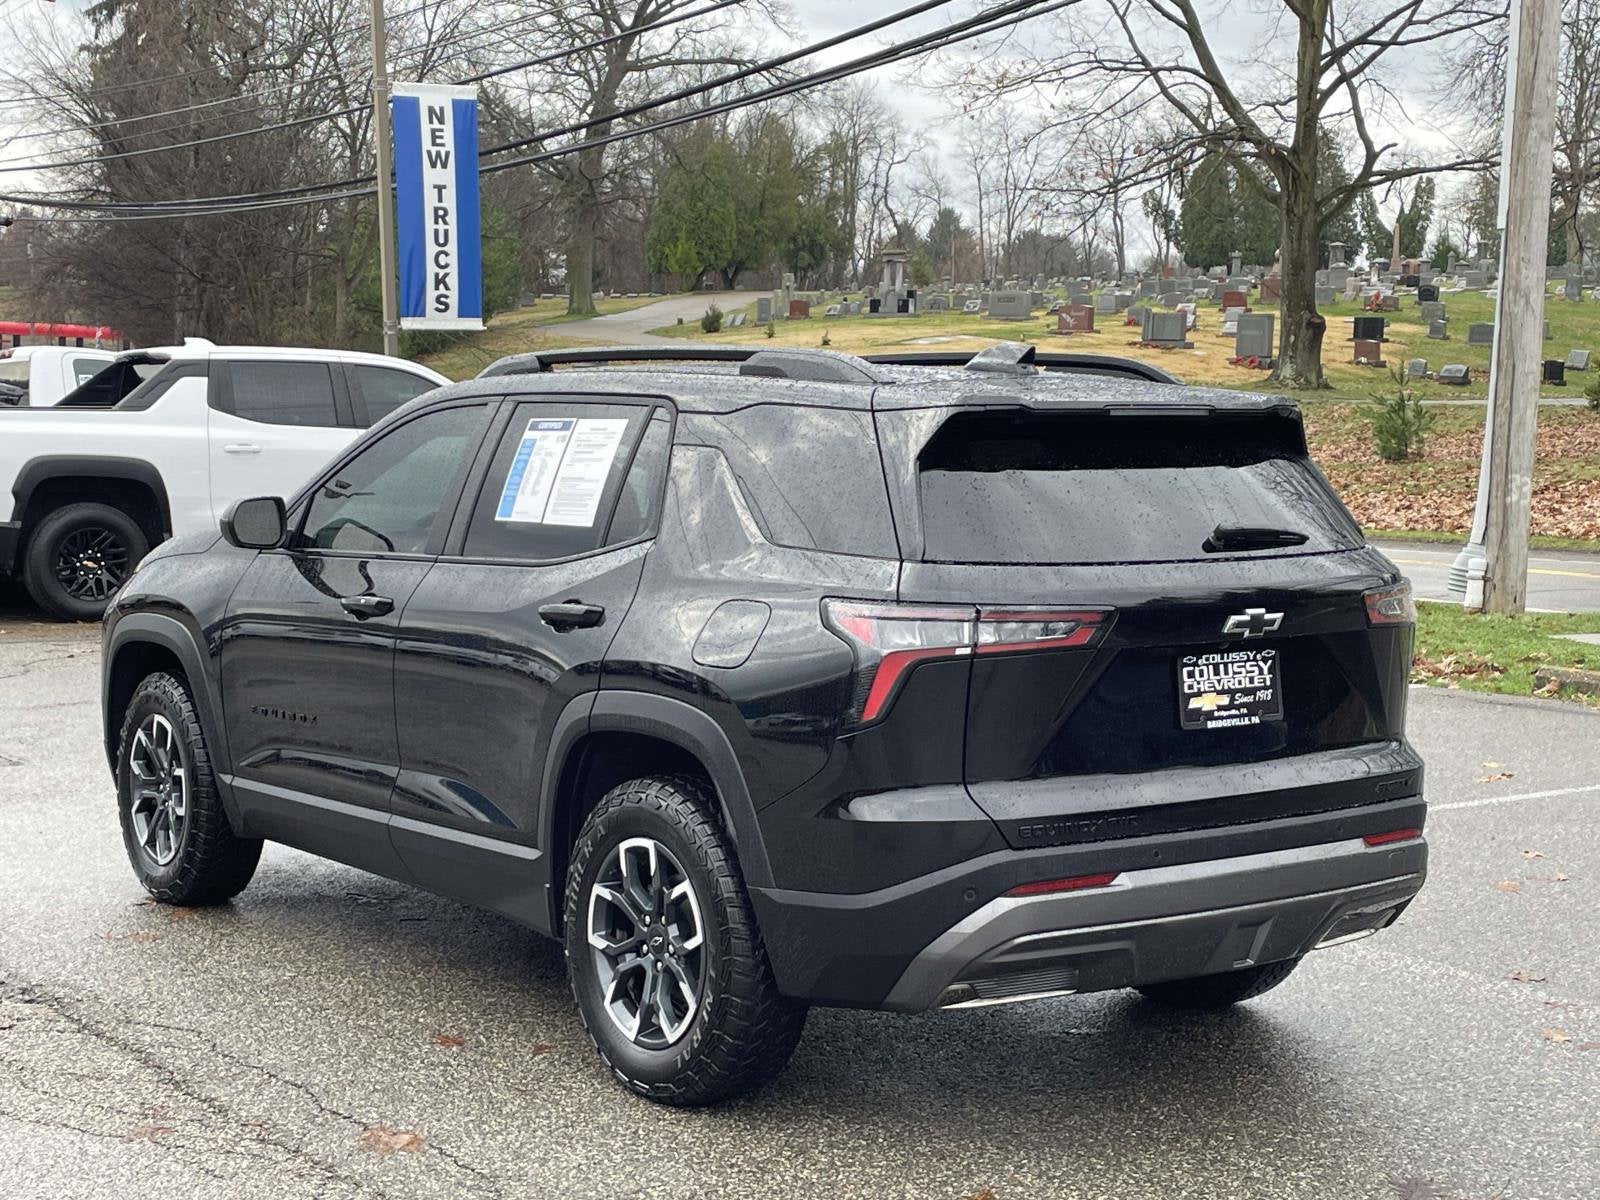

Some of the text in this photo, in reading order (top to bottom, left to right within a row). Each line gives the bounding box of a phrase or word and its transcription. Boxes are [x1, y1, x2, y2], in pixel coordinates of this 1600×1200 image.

[426, 106, 451, 313] NEW TRUCKS
[1202, 651, 1256, 664] COLUSSY
[1182, 660, 1273, 682] COLUSSY
[1183, 674, 1273, 693] CHEVROLET
[1234, 689, 1273, 704] Since 1918
